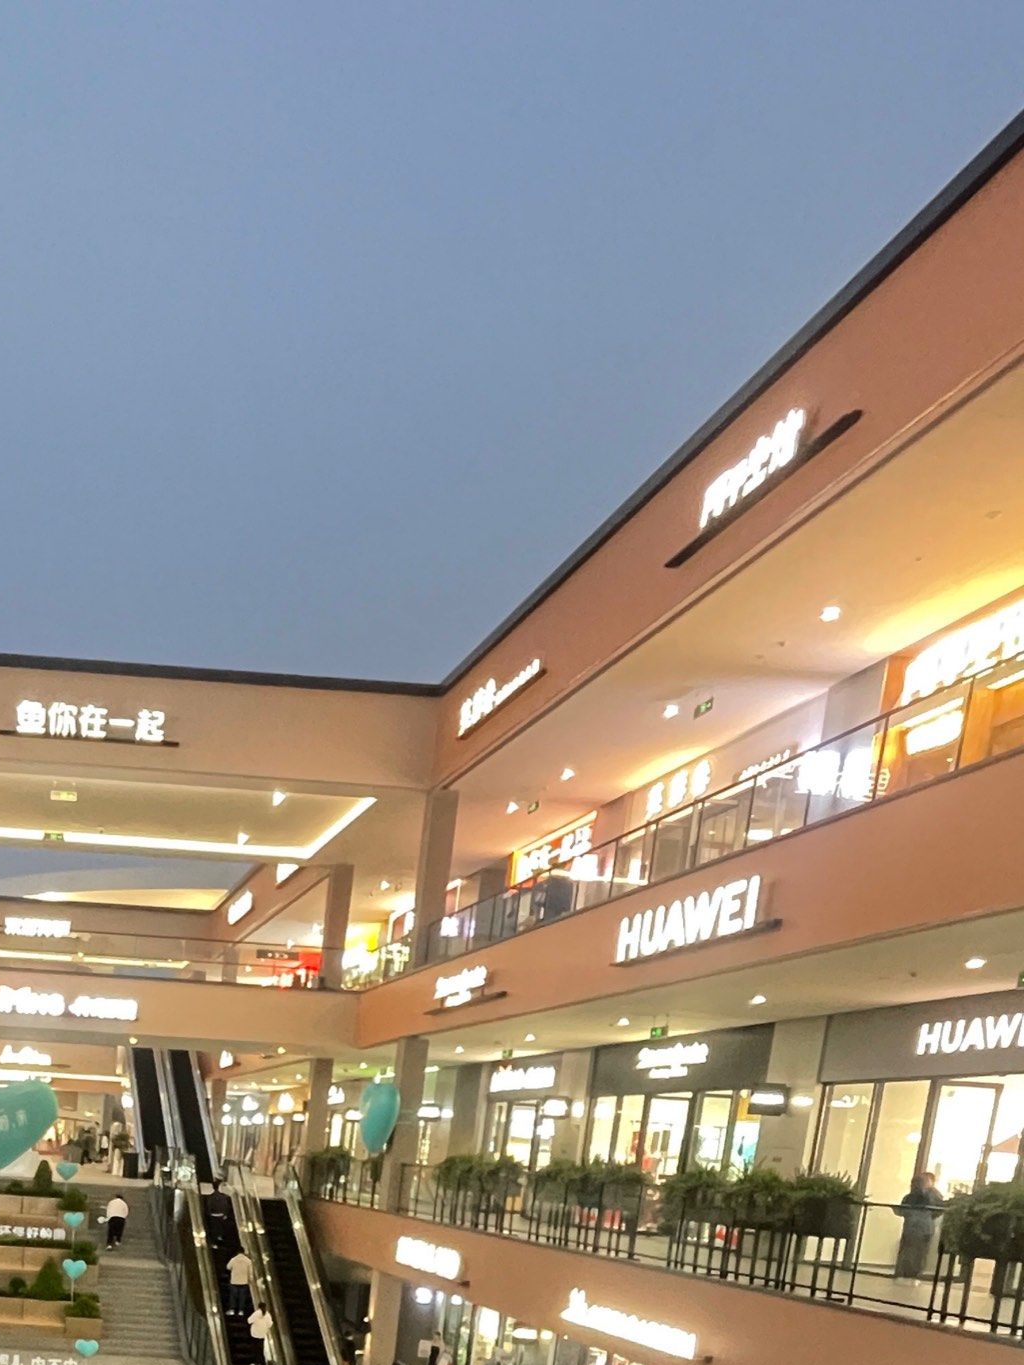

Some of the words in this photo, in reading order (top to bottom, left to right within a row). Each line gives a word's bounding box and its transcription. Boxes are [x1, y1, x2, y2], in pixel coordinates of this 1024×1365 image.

[16, 699, 166, 743] 鱼你在一起
[616, 874, 761, 963] HUAWEI
[916, 1012, 1024, 1056] HUAW
